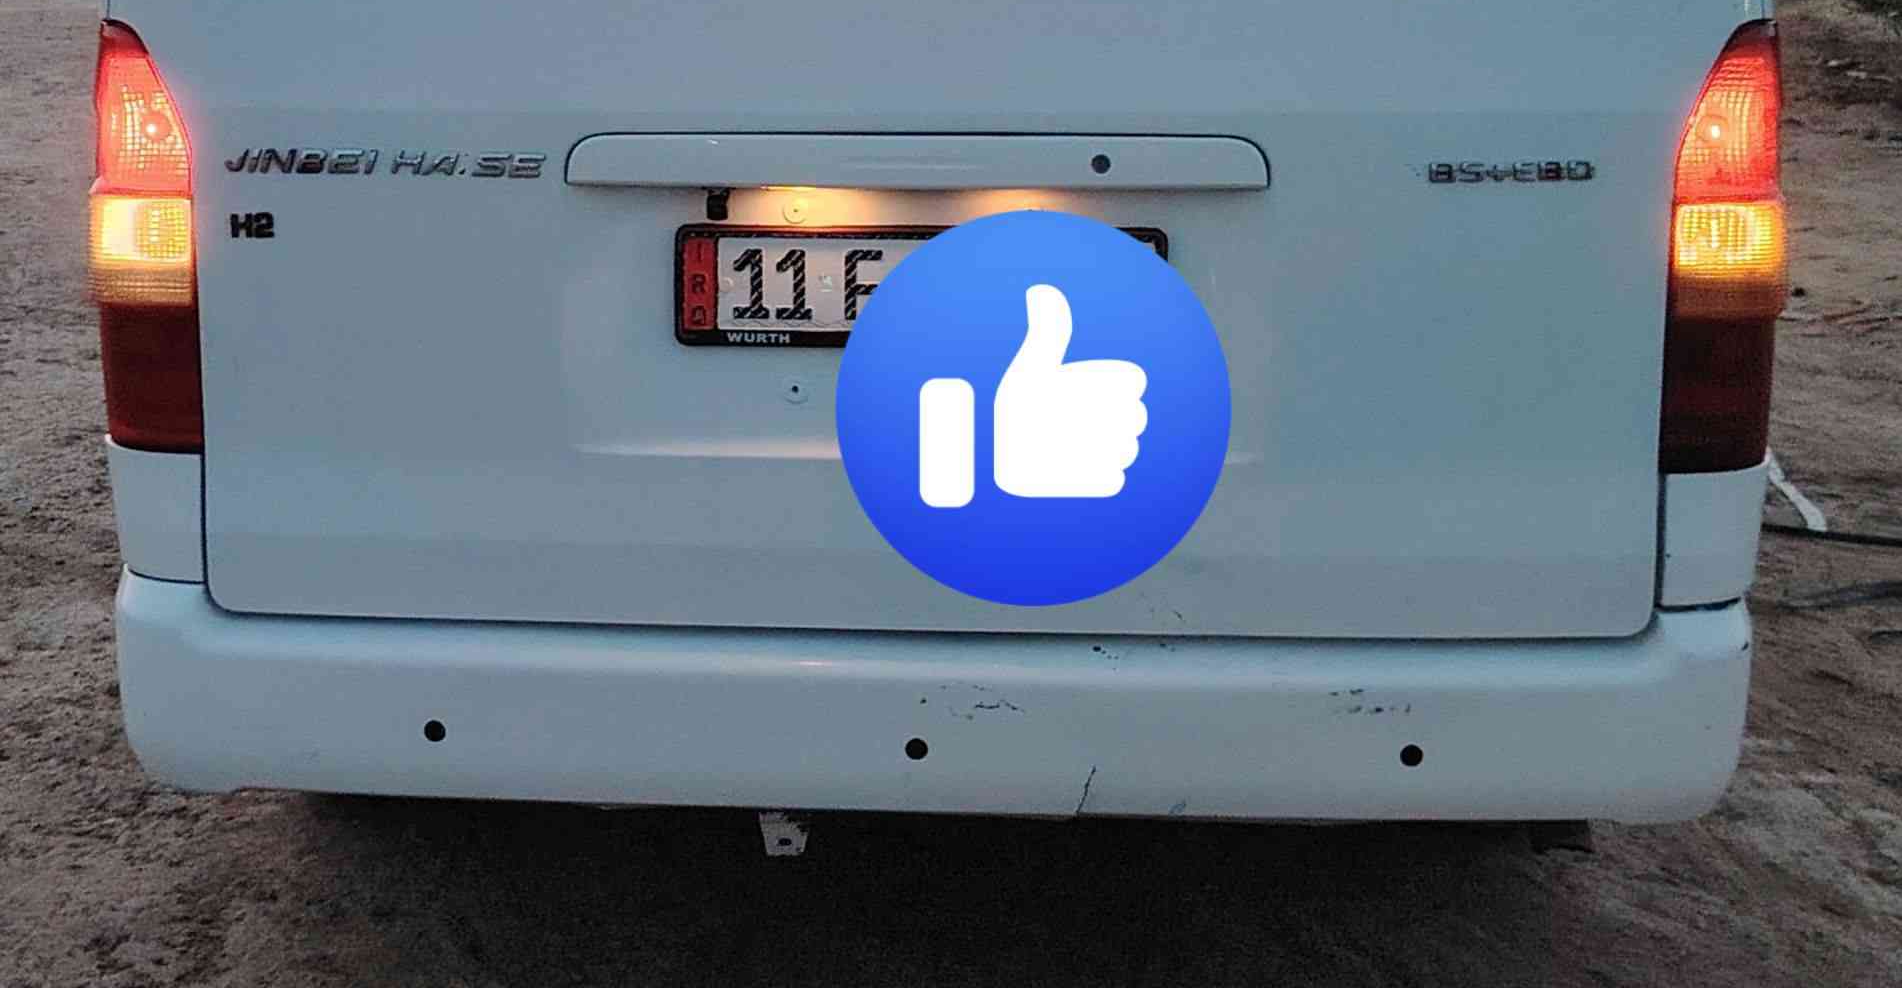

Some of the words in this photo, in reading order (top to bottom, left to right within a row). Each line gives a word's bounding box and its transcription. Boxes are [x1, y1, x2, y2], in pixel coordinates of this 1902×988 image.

[225, 148, 378, 174] JINBEI
[230, 213, 275, 238] H2
[733, 249, 813, 320] 11
